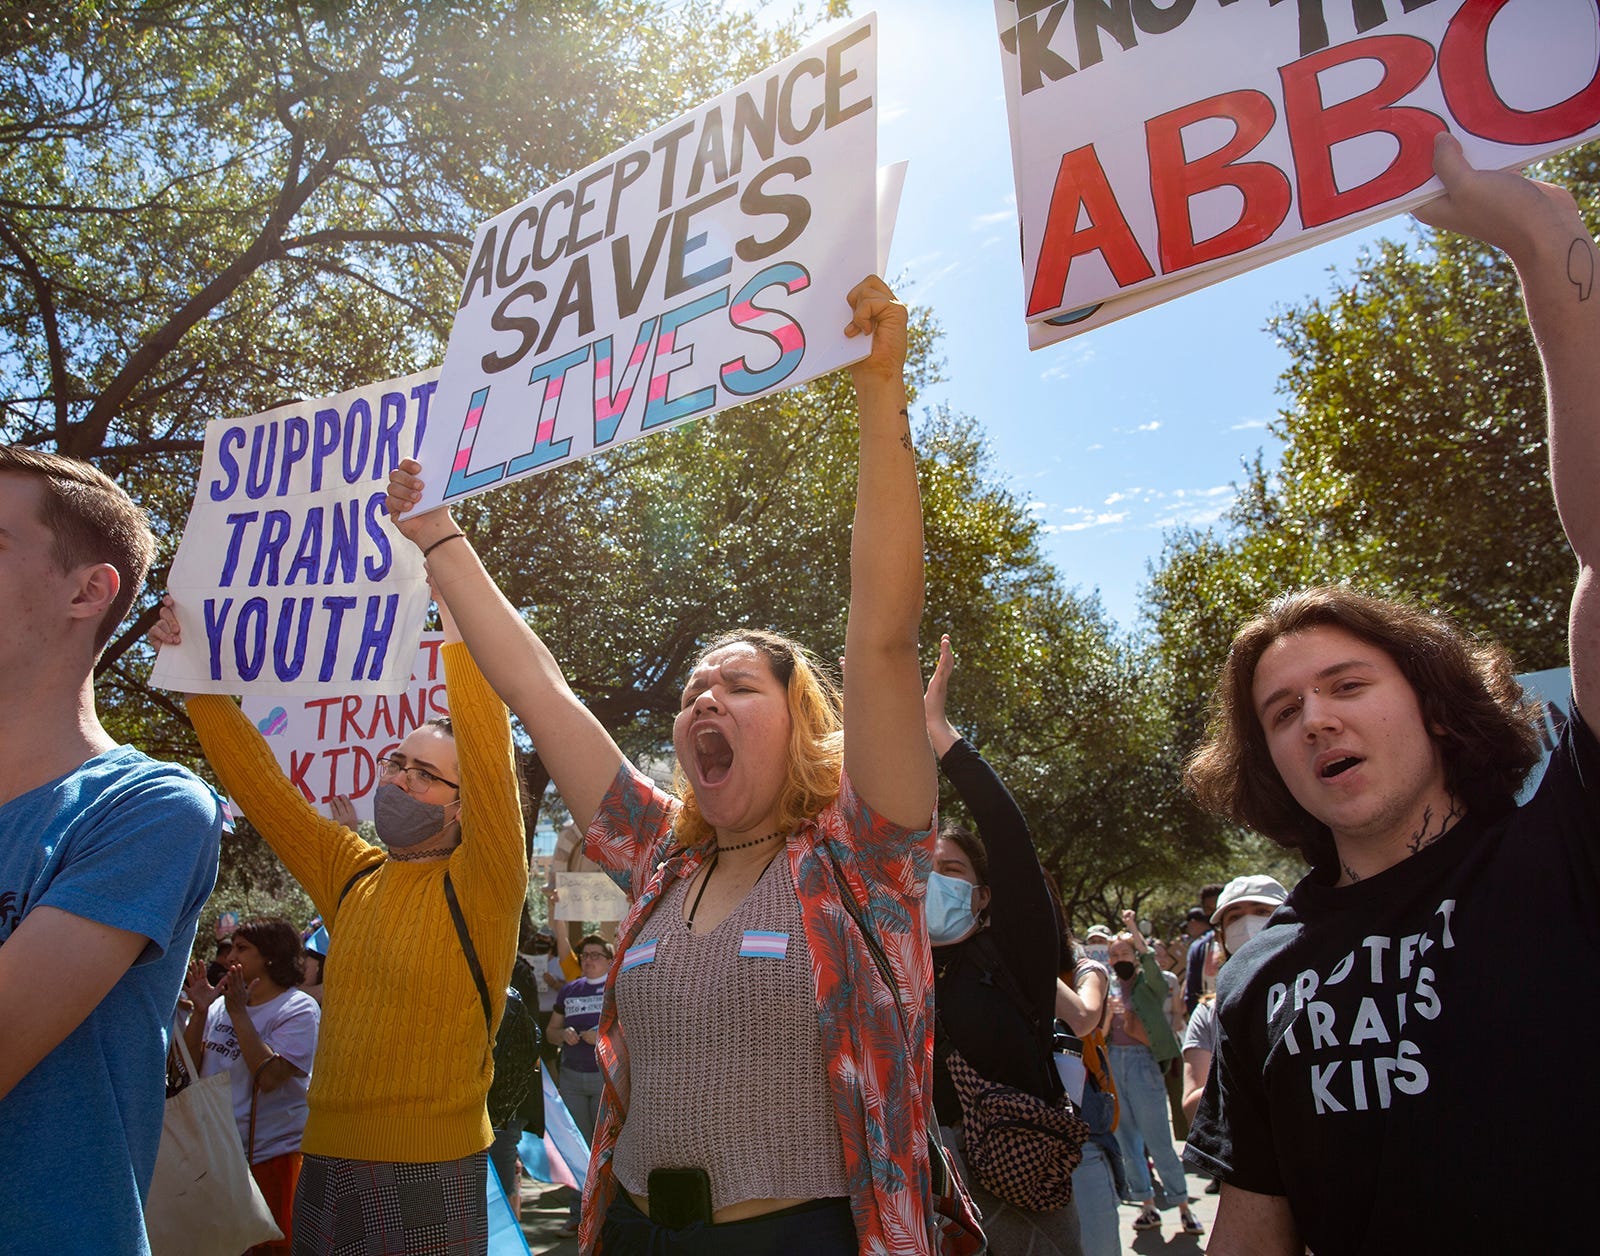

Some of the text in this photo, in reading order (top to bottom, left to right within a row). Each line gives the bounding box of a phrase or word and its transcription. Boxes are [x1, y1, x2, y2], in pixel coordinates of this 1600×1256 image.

[459, 24, 873, 309] ACCEPTANCE
[481, 156, 812, 374] SAVES
[210, 380, 439, 501] SUPPORT
[443, 261, 811, 500] LIVES
[219, 494, 392, 588] TRANS
[204, 594, 400, 683] YOUTH
